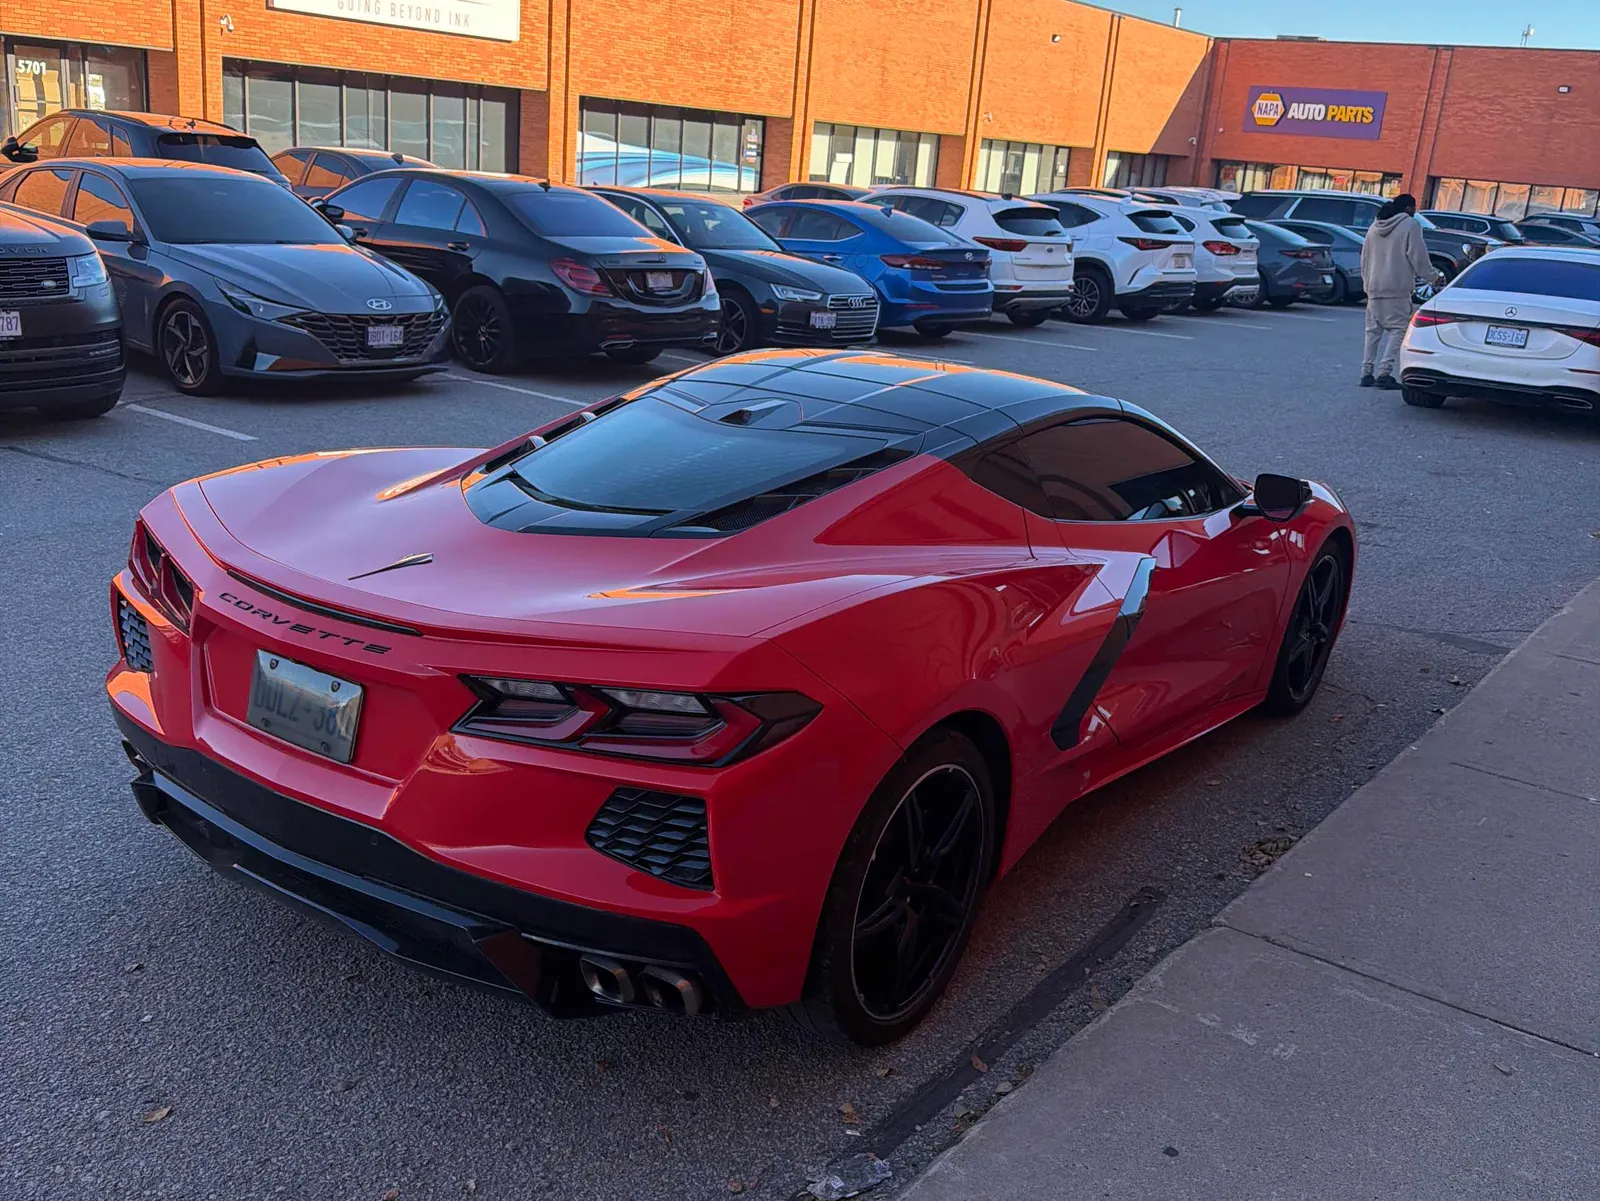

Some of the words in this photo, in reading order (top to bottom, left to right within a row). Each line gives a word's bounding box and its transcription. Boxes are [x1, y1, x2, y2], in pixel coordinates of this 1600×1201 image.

[390, 2, 441, 23] BEYOND
[449, 11, 470, 27] INK
[18, 59, 47, 75] 5701
[1256, 102, 1279, 117] NAPA
[1287, 102, 1326, 121] AUTO
[1326, 104, 1375, 124] PARTS
[219, 592, 392, 654] CORVETTE
